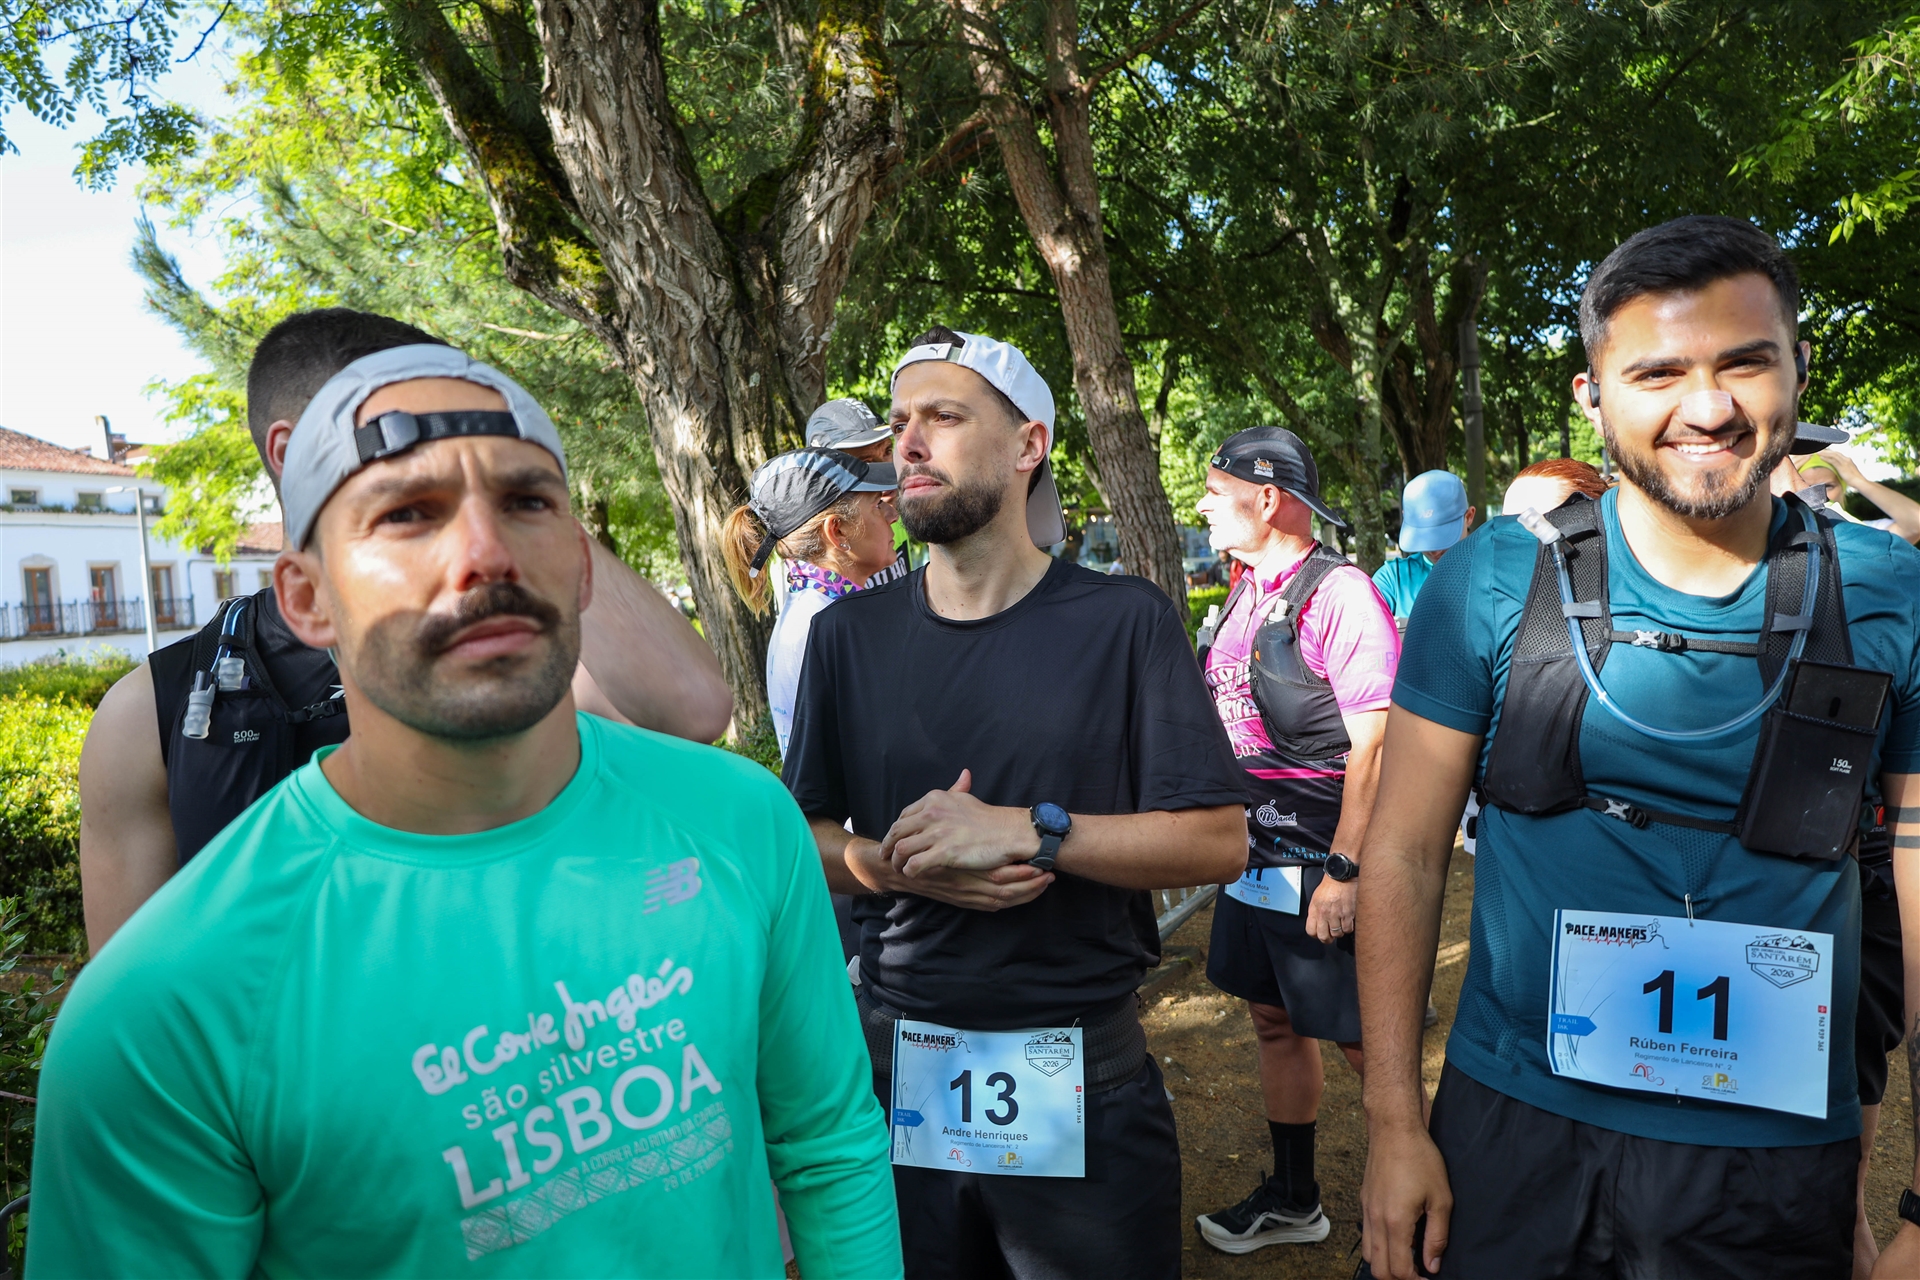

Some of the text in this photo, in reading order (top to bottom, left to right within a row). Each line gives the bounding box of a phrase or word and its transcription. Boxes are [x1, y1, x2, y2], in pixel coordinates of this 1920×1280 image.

[1256, 883, 1270, 891] Mota
[1751, 951, 1812, 965] SANTARÉM
[1770, 967, 1795, 979] 2026
[1643, 969, 1730, 1041] 11
[1557, 1017, 1579, 1025] TRAIL
[412, 1043, 468, 1096] El
[462, 1011, 560, 1075] Corte
[1028, 1046, 1070, 1055] SANTARÉM
[1630, 1036, 1738, 1061] Rúben Ferreira
[1042, 1060, 1059, 1068] 2026
[1634, 1052, 1670, 1064] Regimento
[1670, 1056, 1680, 1064] de
[1680, 1058, 1714, 1069] Lanceiros
[461, 1017, 687, 1130] são silvestre
[950, 1069, 1019, 1126] 13
[442, 1042, 722, 1210] LISBOA
[942, 1126, 1029, 1142] Andre Henriques
[581, 1160, 591, 1175] A
[590, 1143, 633, 1171] CORRER
[633, 1137, 650, 1157] AO
[649, 1124, 683, 1149] RITMO
[681, 1118, 696, 1133] DA
[950, 1139, 974, 1147] Regimento
